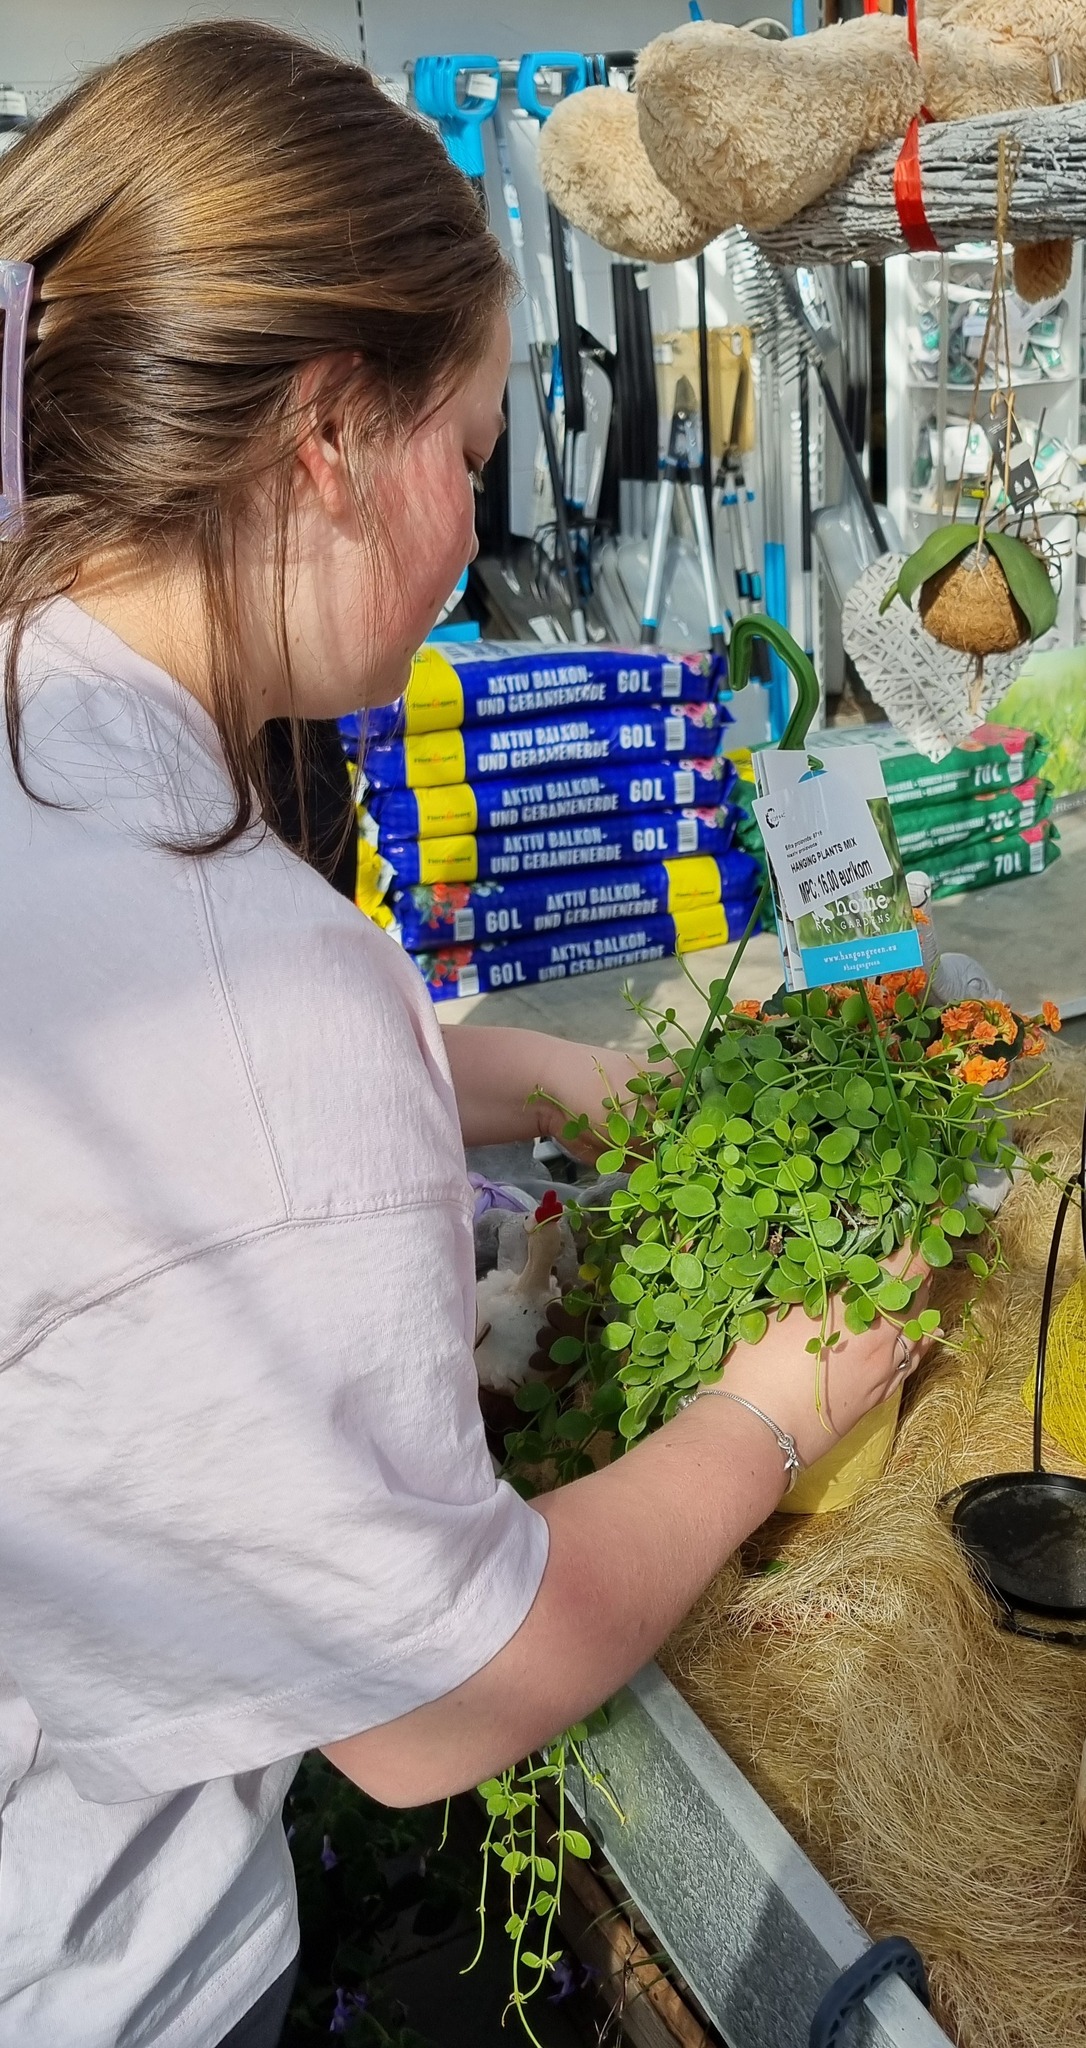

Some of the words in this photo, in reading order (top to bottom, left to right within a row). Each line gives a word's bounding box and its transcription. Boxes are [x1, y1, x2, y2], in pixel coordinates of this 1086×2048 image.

[488, 673, 530, 695] AKTIV
[476, 696, 505, 717] UND
[490, 729, 533, 751] AKTIV
[477, 752, 508, 772] UND
[502, 784, 543, 807] AKTIV
[490, 808, 518, 827] UND
[503, 832, 545, 854] AKTIV
[490, 855, 519, 874] UND
[790, 854, 817, 874] HANGING
[816, 843, 843, 861] PLANTS
[843, 837, 857, 850] MIX
[798, 878, 820, 904] MPC:
[817, 869, 840, 896] 16,00
[546, 888, 587, 912] AKTIV
[835, 894, 889, 917] home
[534, 913, 561, 931] UND
[840, 913, 891, 930] GARDENS
[551, 940, 591, 963] AKTIV
[823, 945, 897, 963] www.hangongreen.eu
[538, 965, 566, 982] UND
